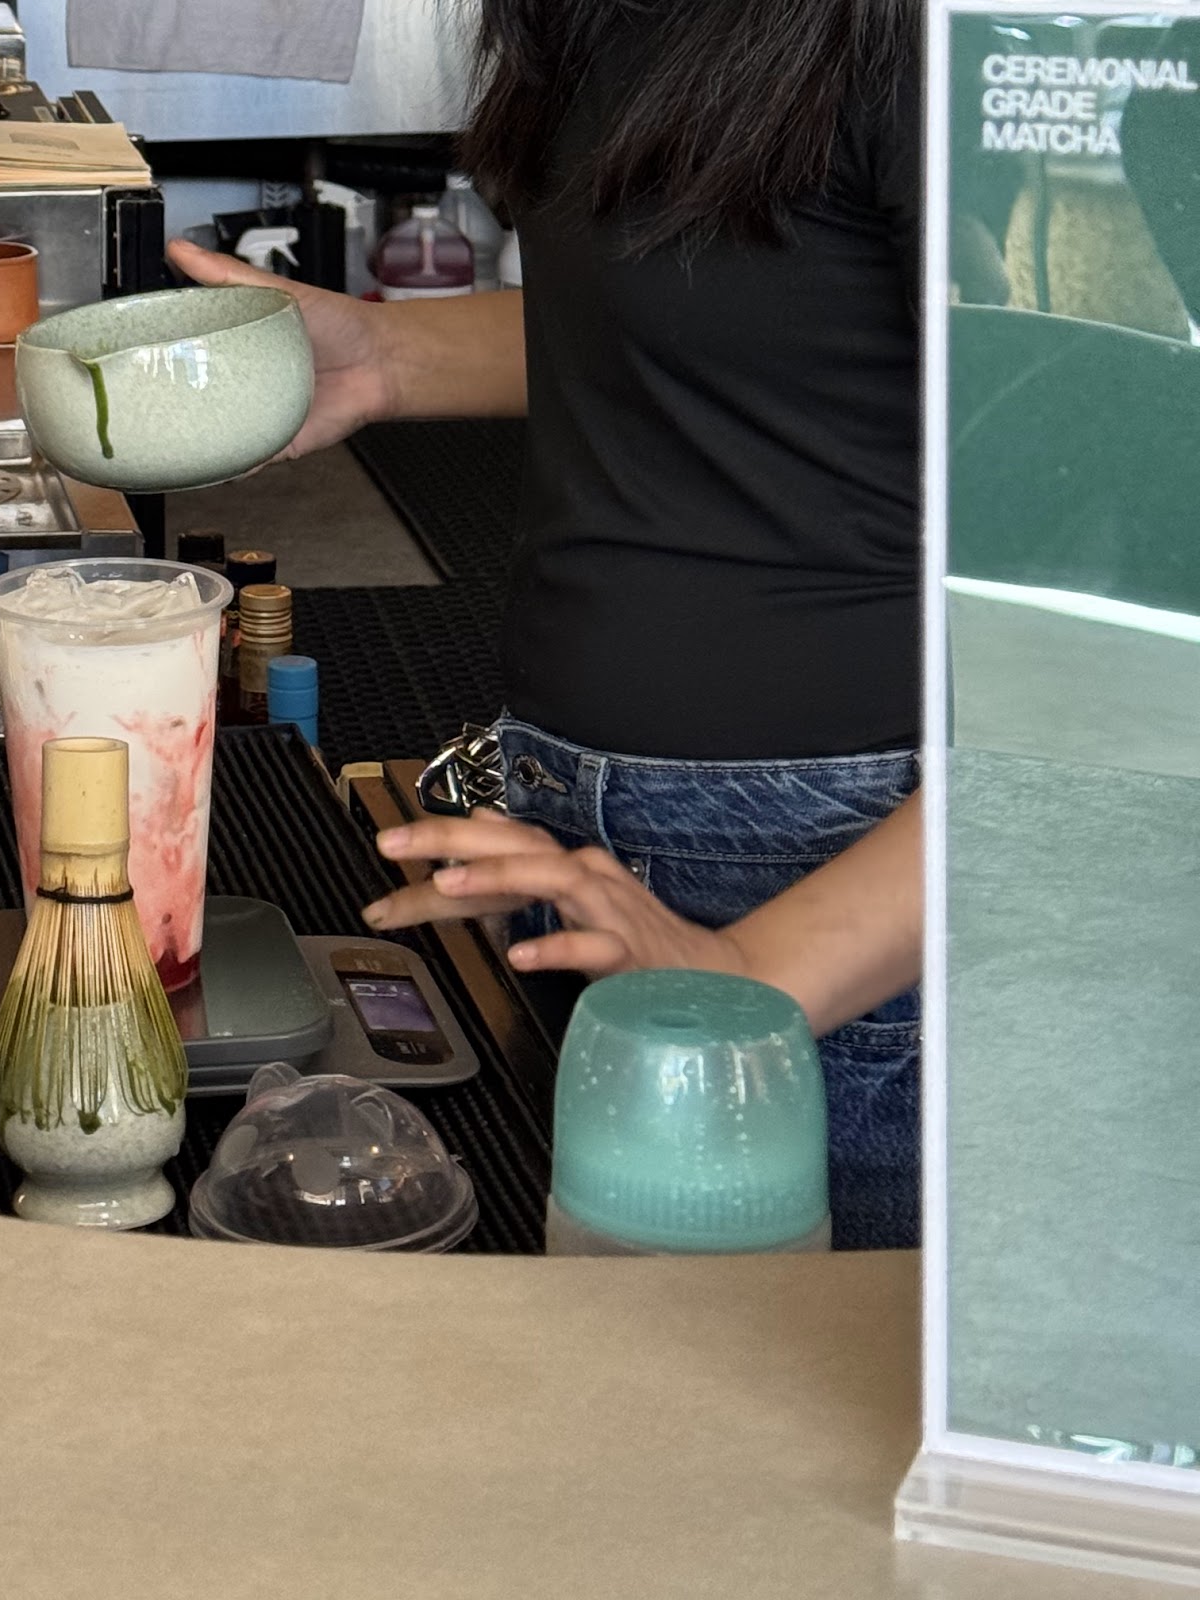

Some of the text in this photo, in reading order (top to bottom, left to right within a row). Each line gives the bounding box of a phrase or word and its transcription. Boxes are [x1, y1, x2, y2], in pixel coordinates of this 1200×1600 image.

[982, 54, 1199, 90] CEREMONIAL
[982, 87, 1097, 120] GRADE
[982, 120, 1122, 154] MATCHA
